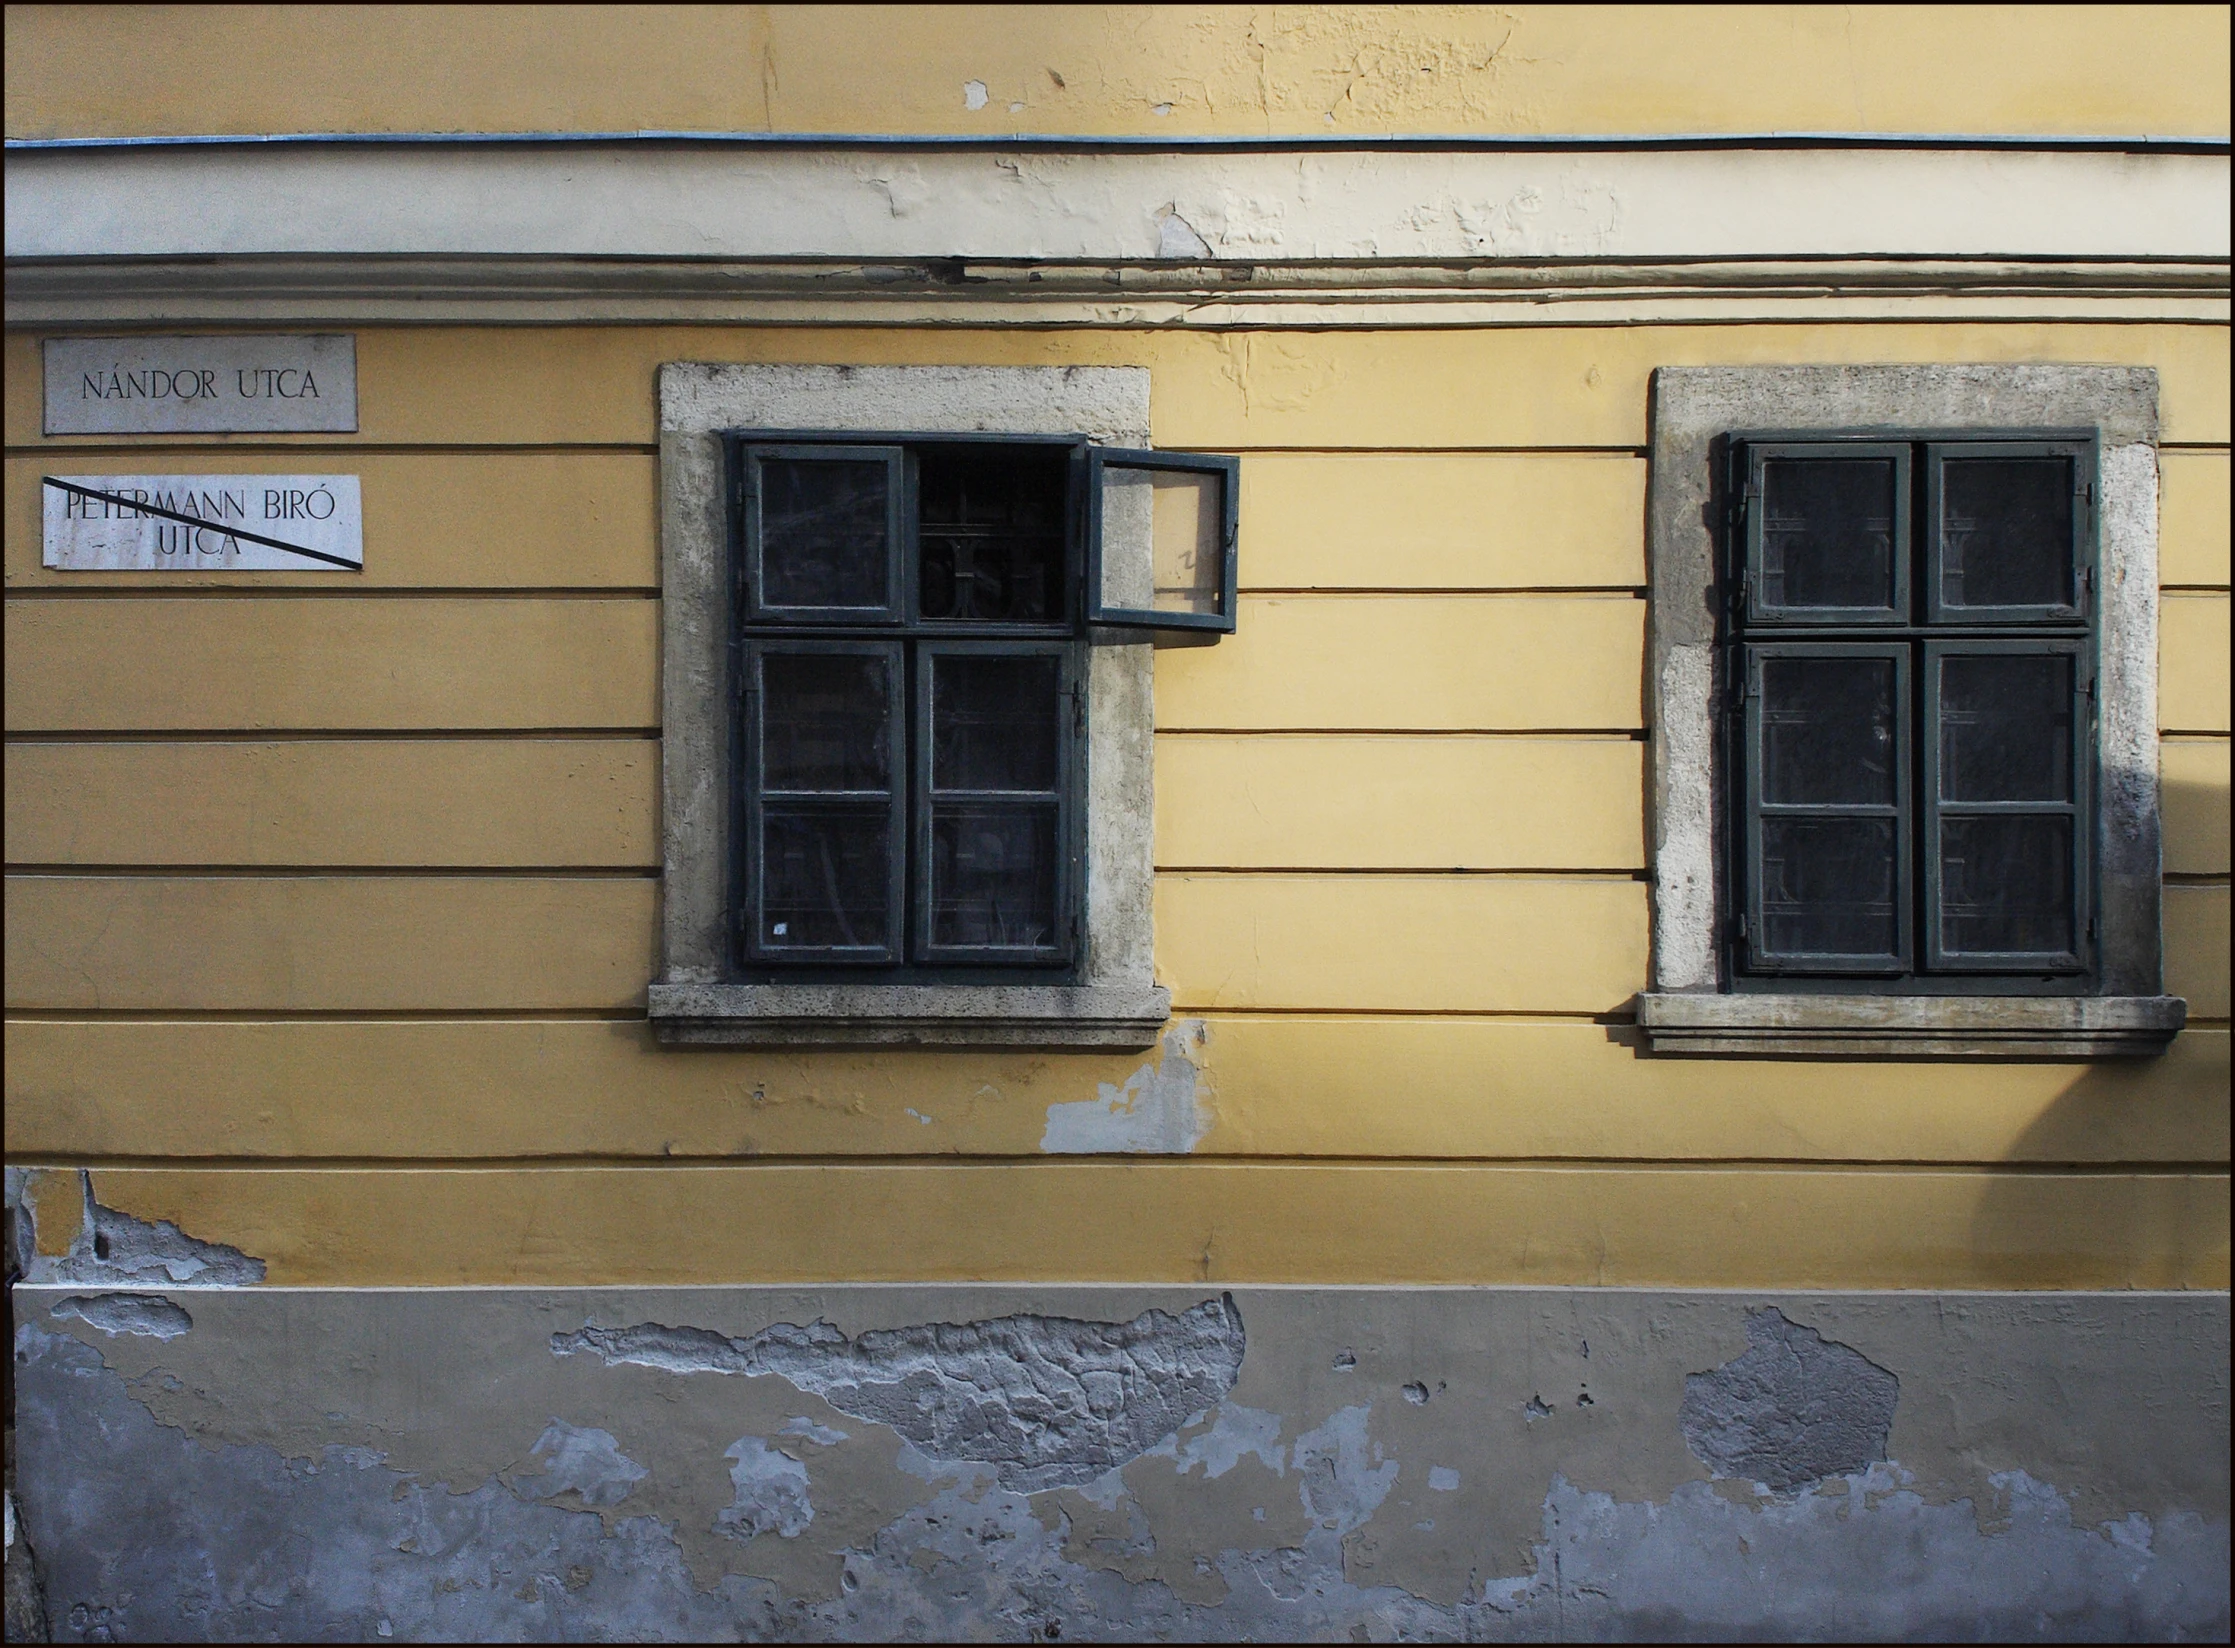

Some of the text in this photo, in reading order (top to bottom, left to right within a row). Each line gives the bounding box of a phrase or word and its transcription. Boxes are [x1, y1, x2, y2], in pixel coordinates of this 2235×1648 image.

[82, 363, 320, 399] NÁNDOR UTCA
[66, 483, 335, 520] PETERMANN BIRÓ
[159, 525, 241, 555] UTCA
